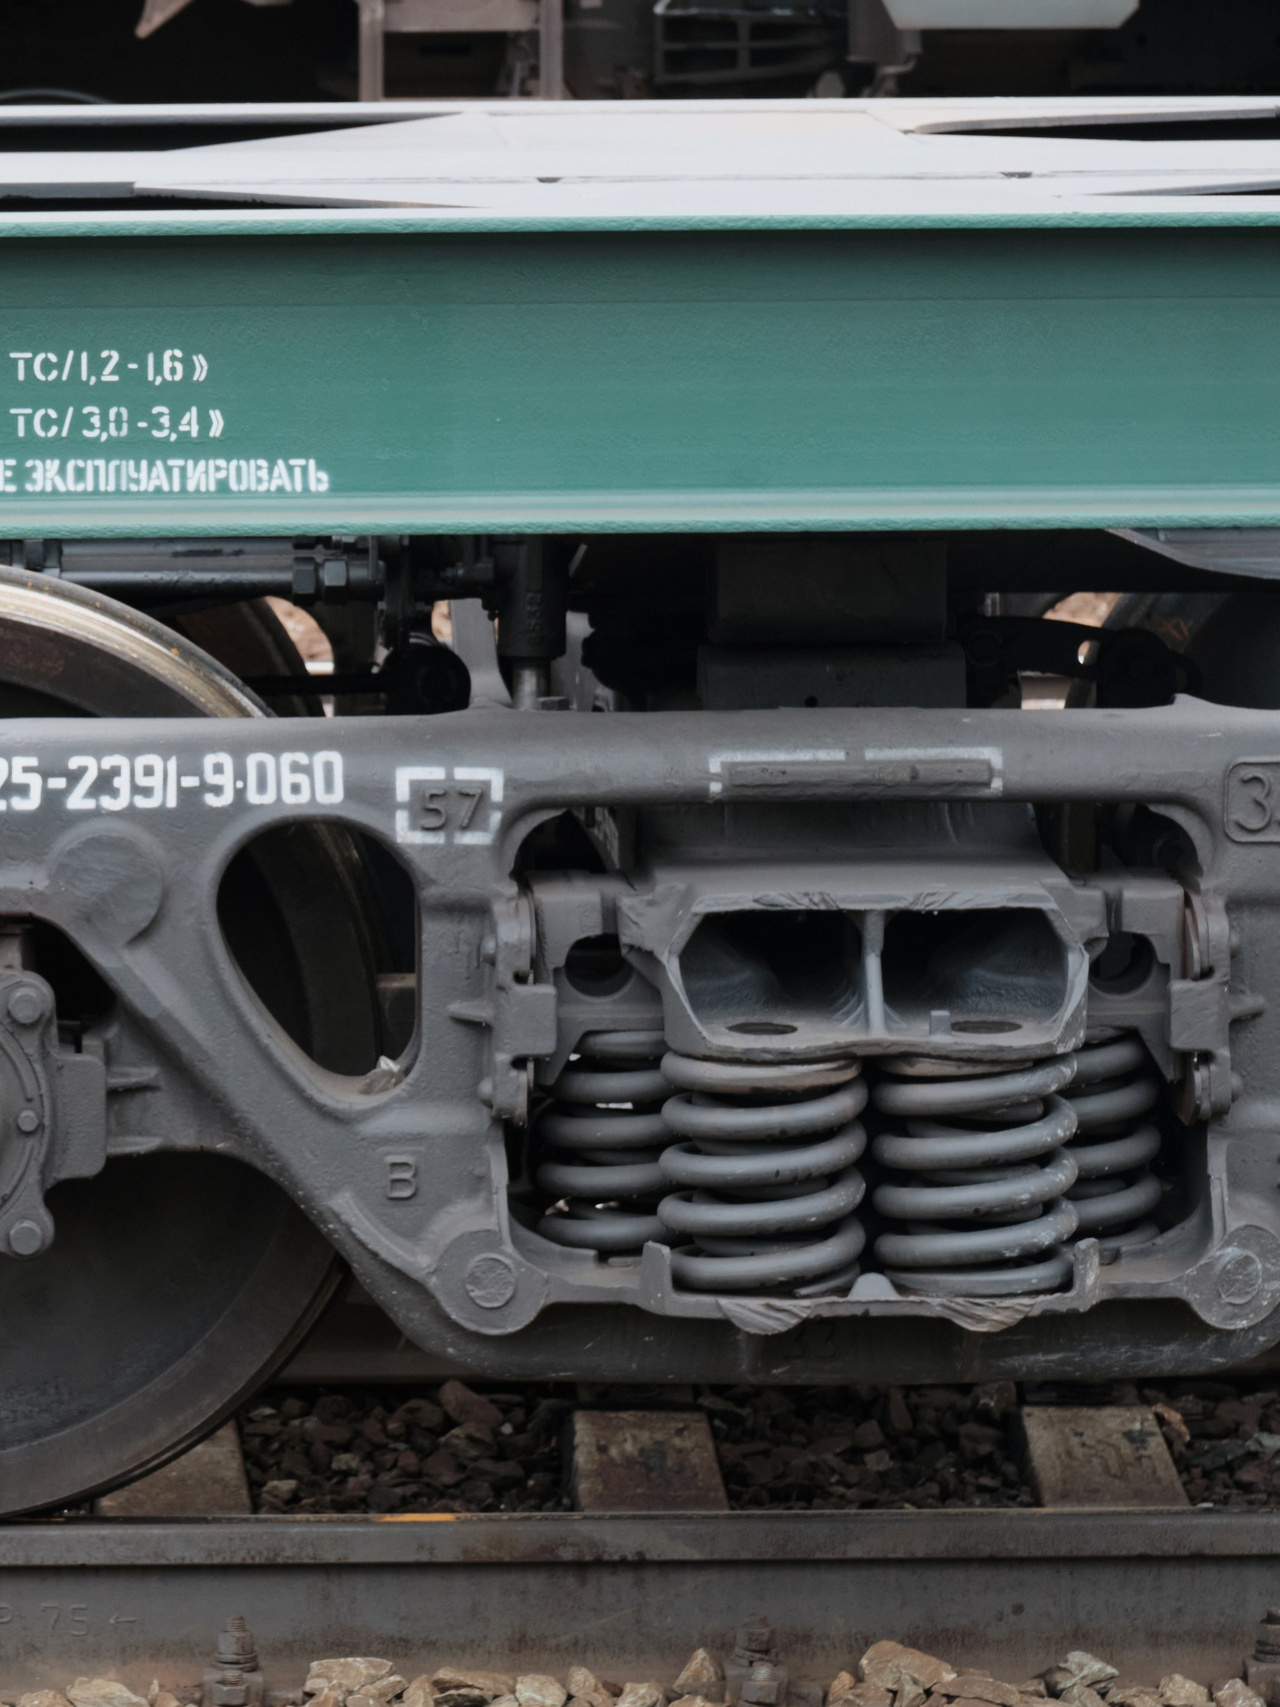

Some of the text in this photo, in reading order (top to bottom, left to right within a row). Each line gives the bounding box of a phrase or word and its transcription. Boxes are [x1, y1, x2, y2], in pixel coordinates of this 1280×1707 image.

[24, 458, 331, 493] ЭКСПЛУАТИРОВАТЬ
[420, 786, 483, 831] 57
[1234, 771, 1280, 834] 3
